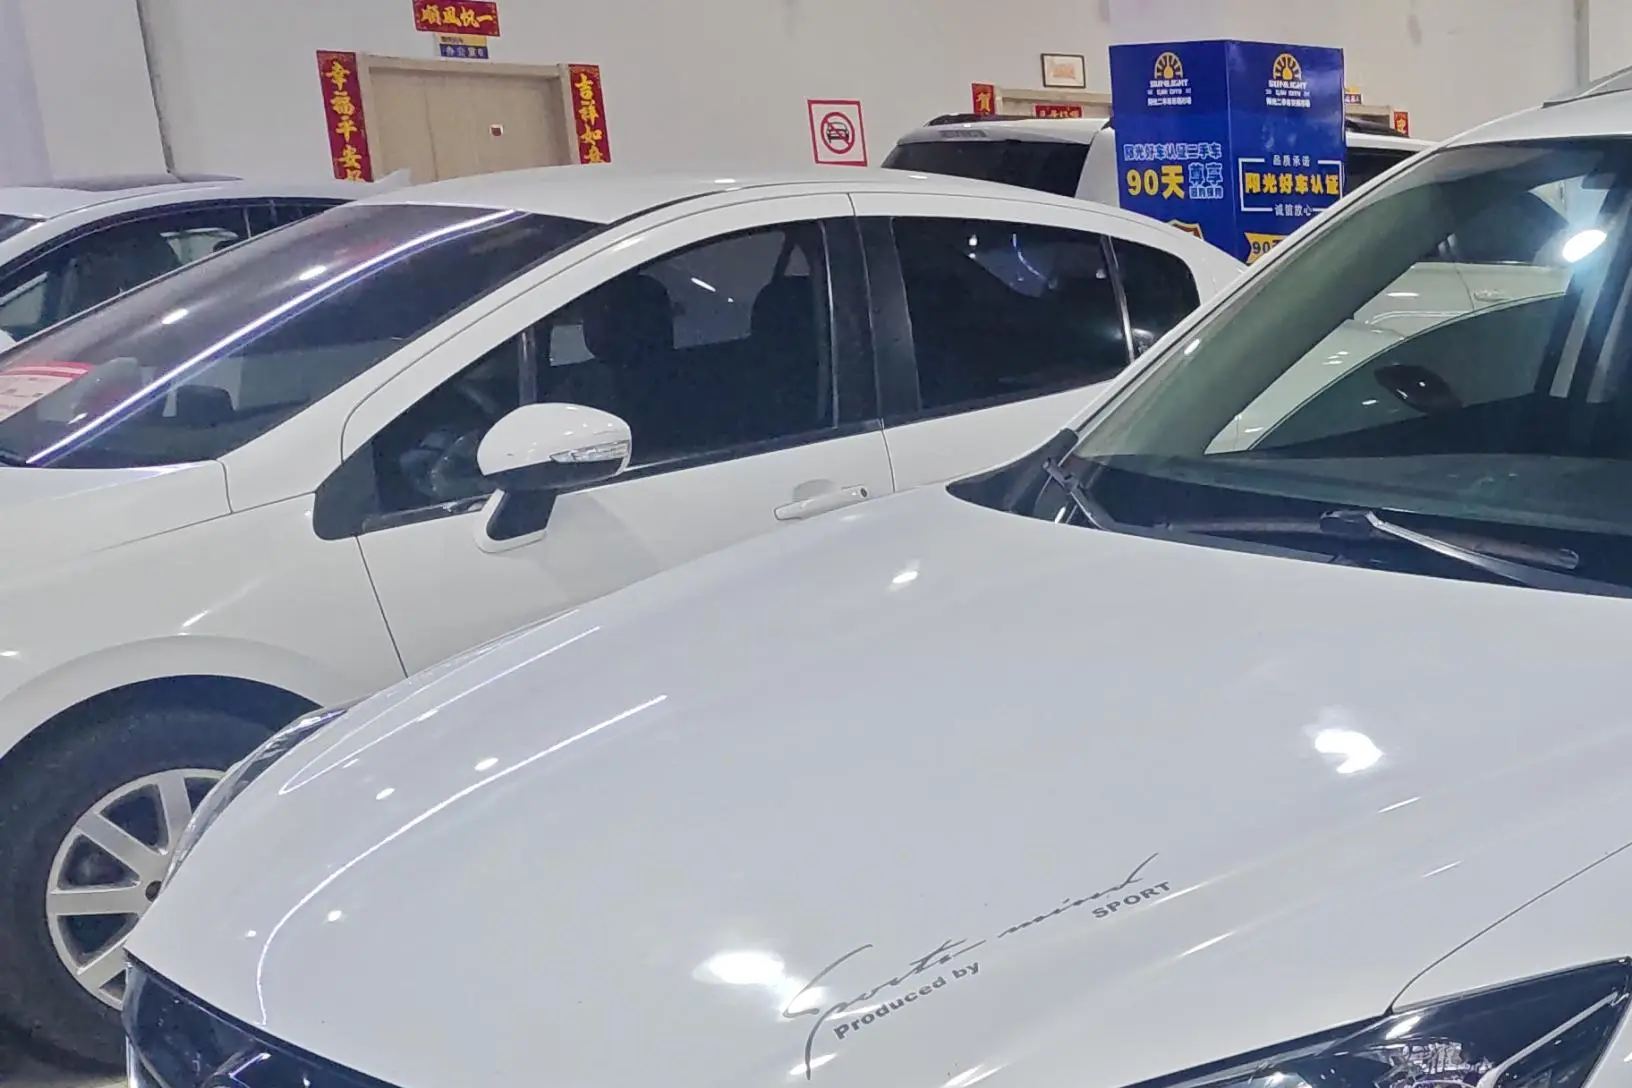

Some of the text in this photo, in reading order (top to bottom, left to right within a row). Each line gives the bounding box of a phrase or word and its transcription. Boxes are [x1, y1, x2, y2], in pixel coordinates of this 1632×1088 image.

[1123, 142, 1223, 161] 阳光好车认证二手车
[1273, 154, 1310, 167] 品质承诺
[1127, 166, 1185, 200] 90天
[1244, 172, 1340, 195] 阳光好车认证
[1275, 203, 1313, 217] 诚信放心
[1253, 240, 1284, 255] 90
[833, 881, 1171, 1040] Produced by SPORT
